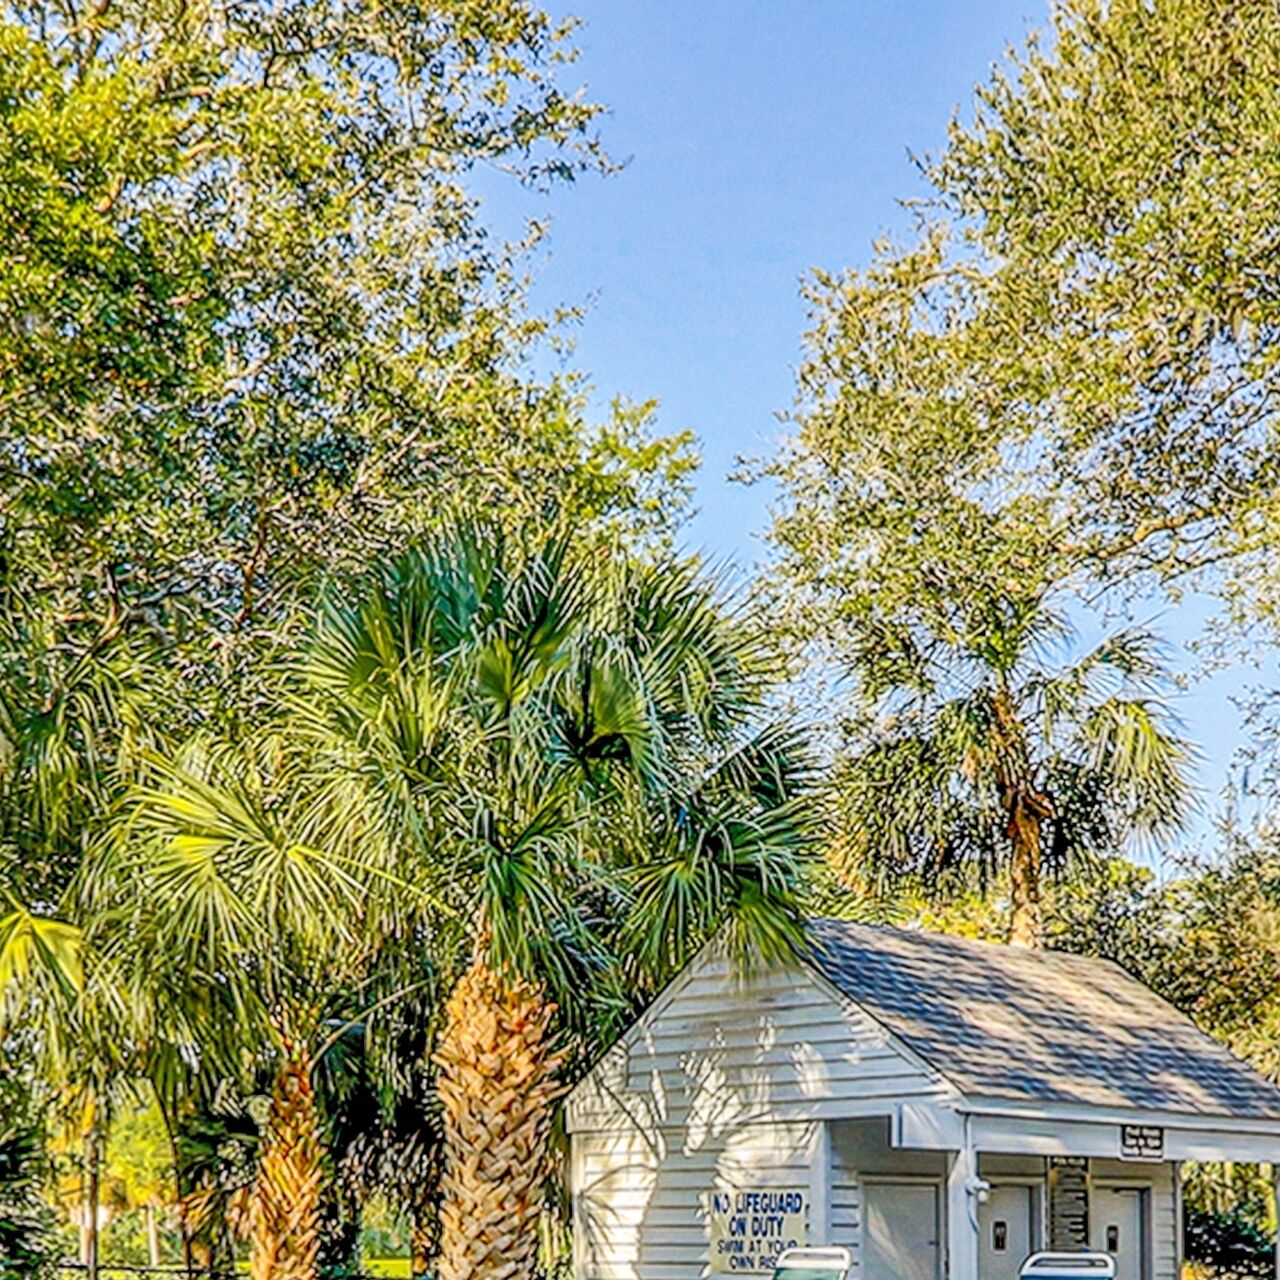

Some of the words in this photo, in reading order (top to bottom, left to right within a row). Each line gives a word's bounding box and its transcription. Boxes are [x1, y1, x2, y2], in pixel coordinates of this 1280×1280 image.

[713, 1193, 731, 1214] NO
[736, 1192, 803, 1214] LIFEGUARD
[729, 1215, 746, 1236] ON
[752, 1215, 784, 1236] DUTY
[718, 1239, 744, 1254] SWIM
[749, 1239, 762, 1253] AT
[759, 1255, 779, 1270] RIS
